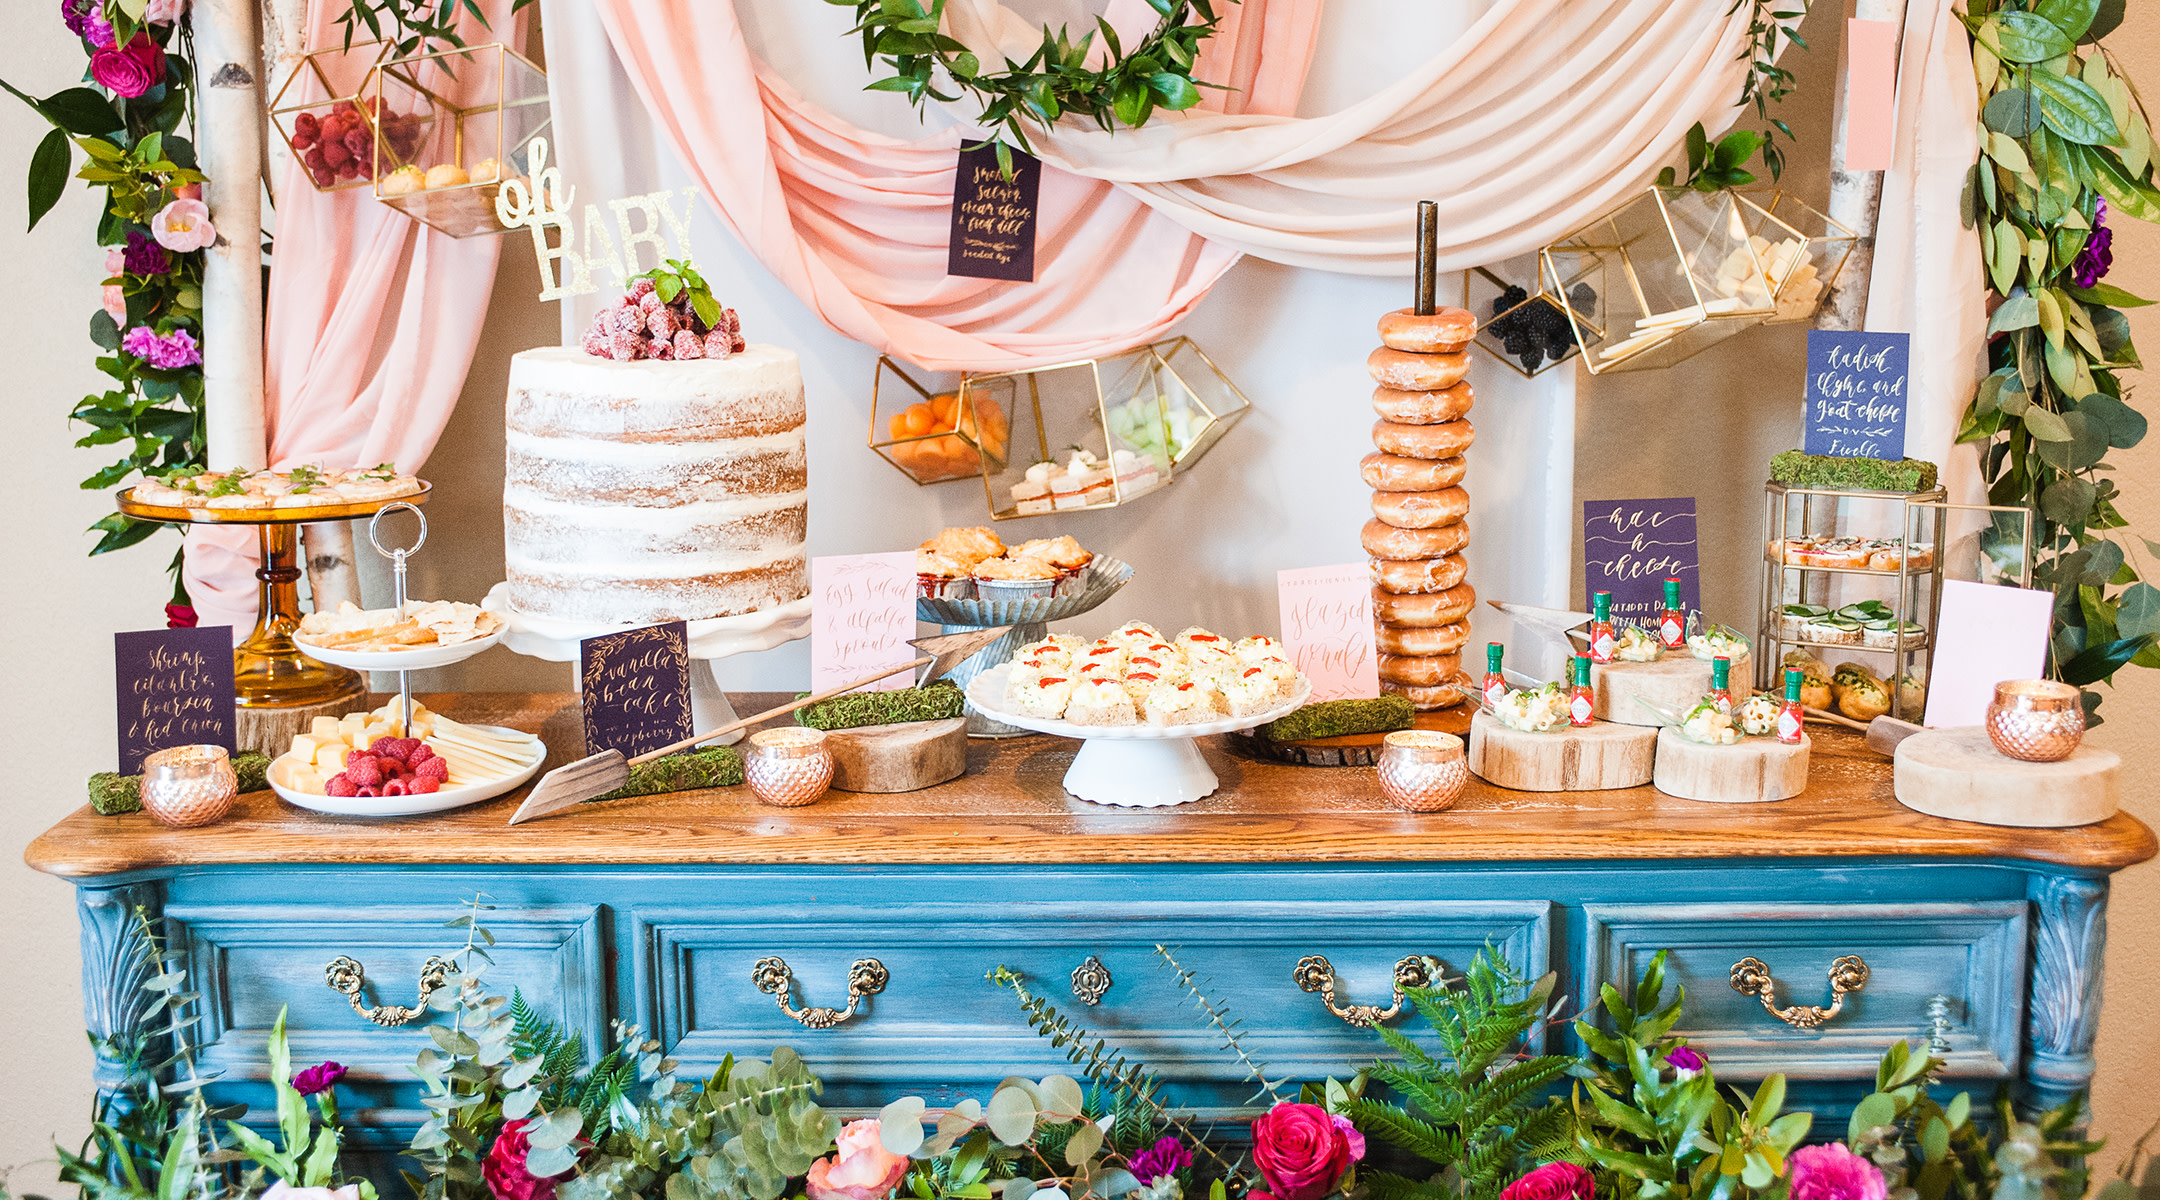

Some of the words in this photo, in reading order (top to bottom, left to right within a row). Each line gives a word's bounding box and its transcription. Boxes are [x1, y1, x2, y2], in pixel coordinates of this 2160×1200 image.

[495, 136, 576, 229] oh
[996, 219, 1026, 236] dill
[521, 185, 701, 302] BABY
[1872, 375, 1905, 397] and
[1815, 399, 1858, 423] goat
[1856, 396, 1900, 423] cheese
[1603, 553, 1682, 581] cheese
[604, 647, 673, 680] vanilla
[602, 674, 660, 703] bean
[622, 690, 680, 715] cake
[144, 718, 173, 746] Red
